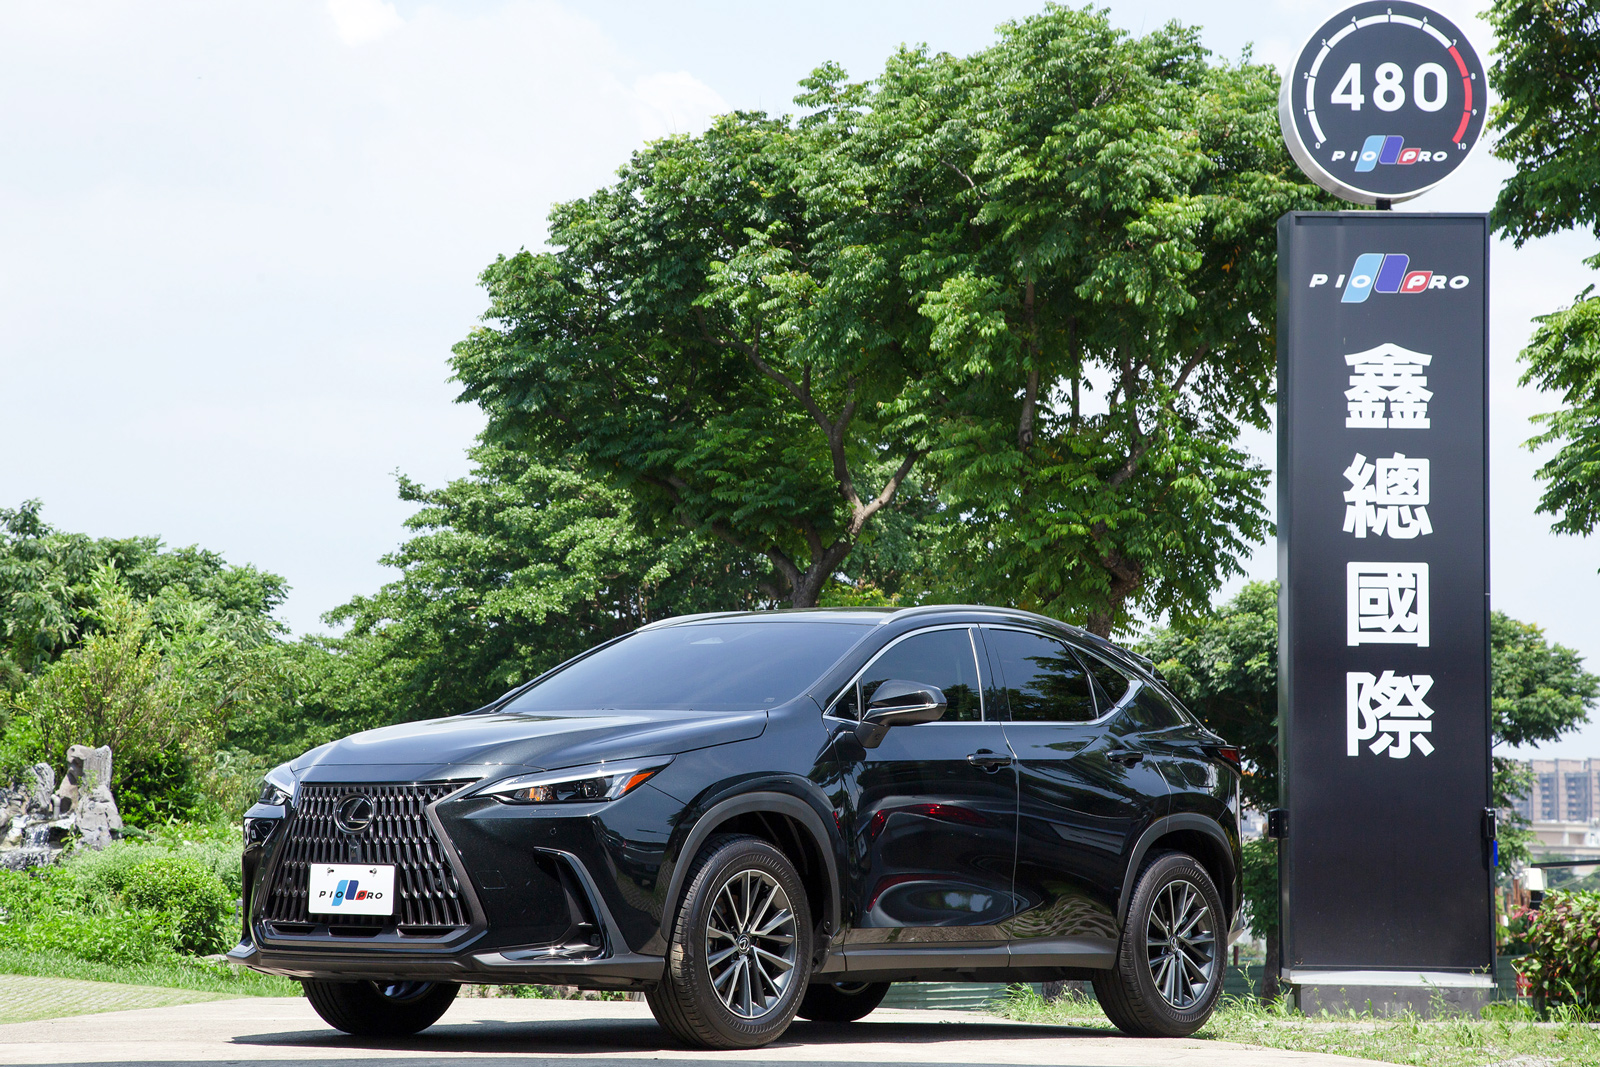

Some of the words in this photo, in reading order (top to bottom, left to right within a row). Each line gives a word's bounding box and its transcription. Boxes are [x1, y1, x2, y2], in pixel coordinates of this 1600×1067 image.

[1321, 38, 1327, 46] 3
[1330, 62, 1448, 112] 480
[1331, 150, 1377, 162] PIO
[1401, 150, 1448, 162] PRO
[1309, 273, 1372, 288] PIO
[1406, 274, 1470, 289] PRO
[1343, 342, 1435, 759] 鑫總國際
[319, 890, 344, 899] PIO
[358, 891, 383, 900] PRO
